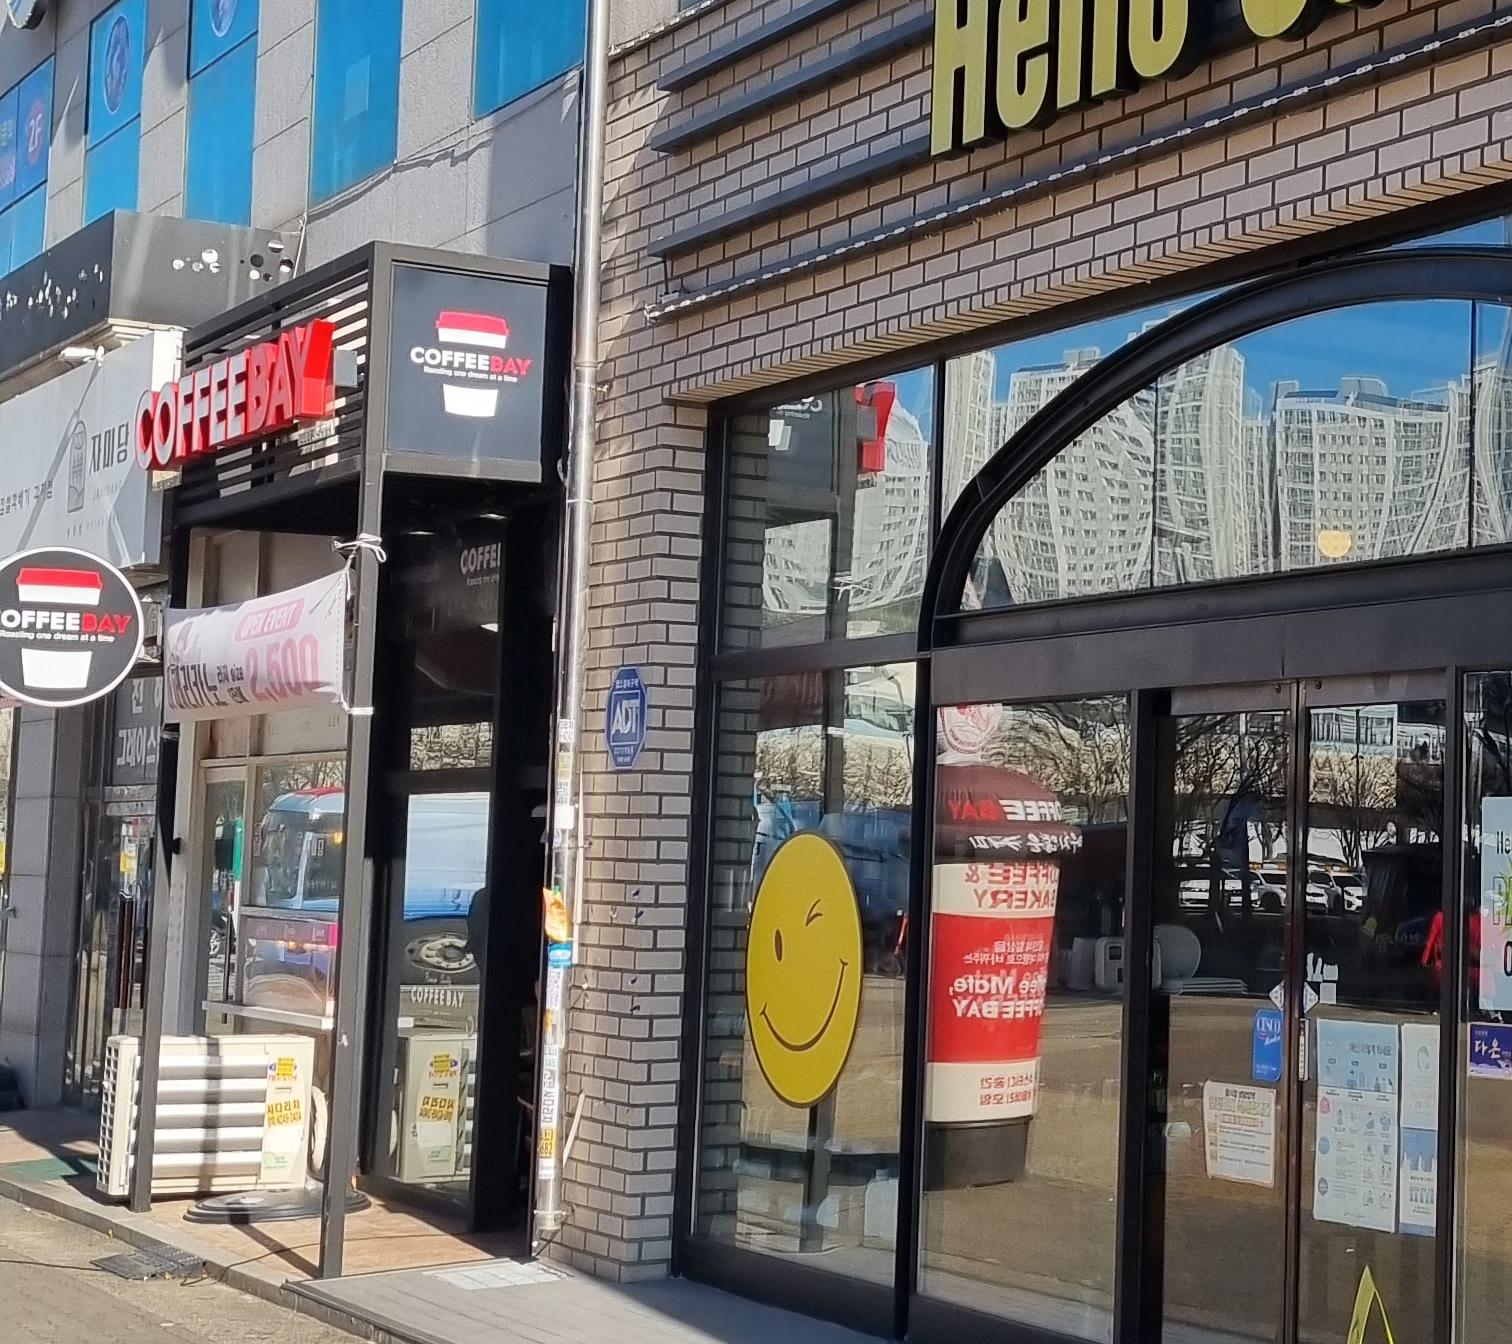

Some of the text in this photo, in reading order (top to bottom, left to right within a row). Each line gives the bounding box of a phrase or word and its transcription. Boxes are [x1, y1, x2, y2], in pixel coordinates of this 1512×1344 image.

[409, 346, 532, 376] COFFEEBAY
[135, 318, 335, 472] COFFEEBAY
[88, 421, 130, 476] 자미당
[0, 608, 132, 634] OFFEEBAY
[245, 632, 320, 703] 2,500
[611, 699, 640, 735] ADT
[1474, 1038, 1502, 1060] 다온
